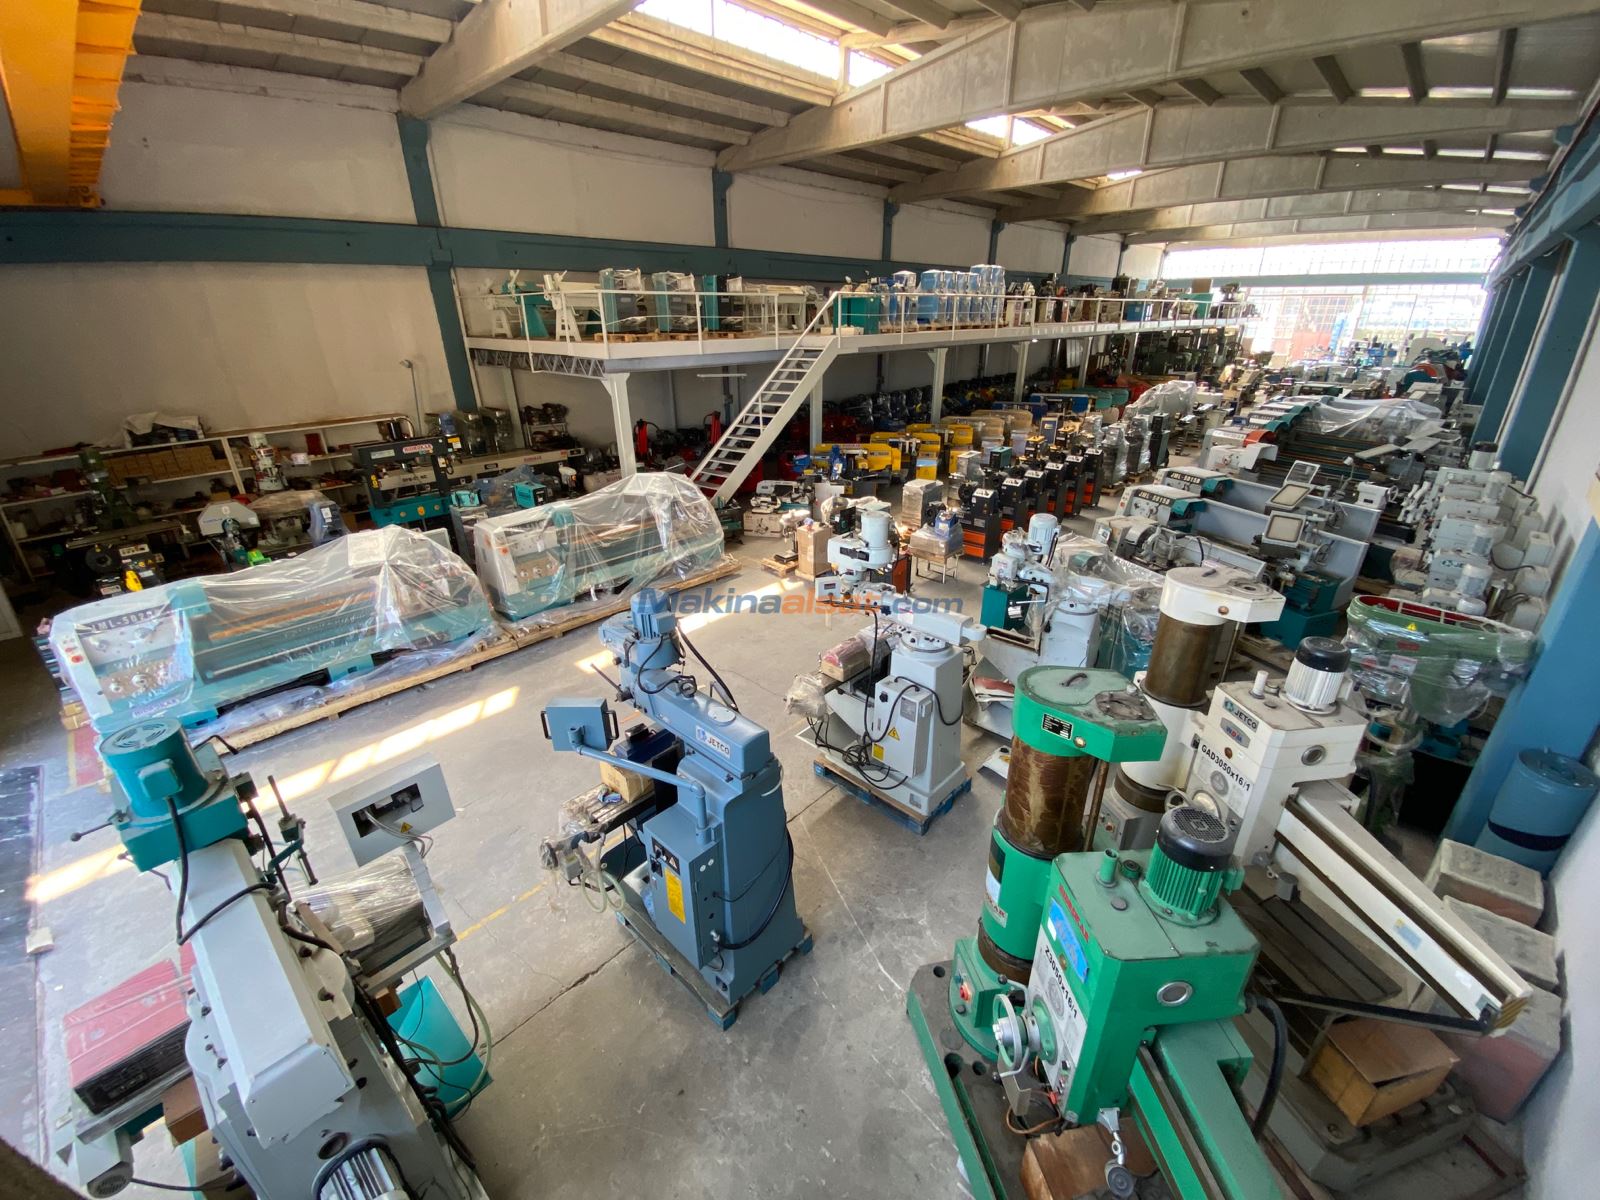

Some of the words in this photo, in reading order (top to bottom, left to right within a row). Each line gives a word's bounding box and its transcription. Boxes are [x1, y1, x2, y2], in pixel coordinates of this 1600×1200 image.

[1234, 710, 1258, 730] JETCO
[707, 737, 730, 755] JETCO
[1201, 744, 1251, 792] GAD3050x16/1
